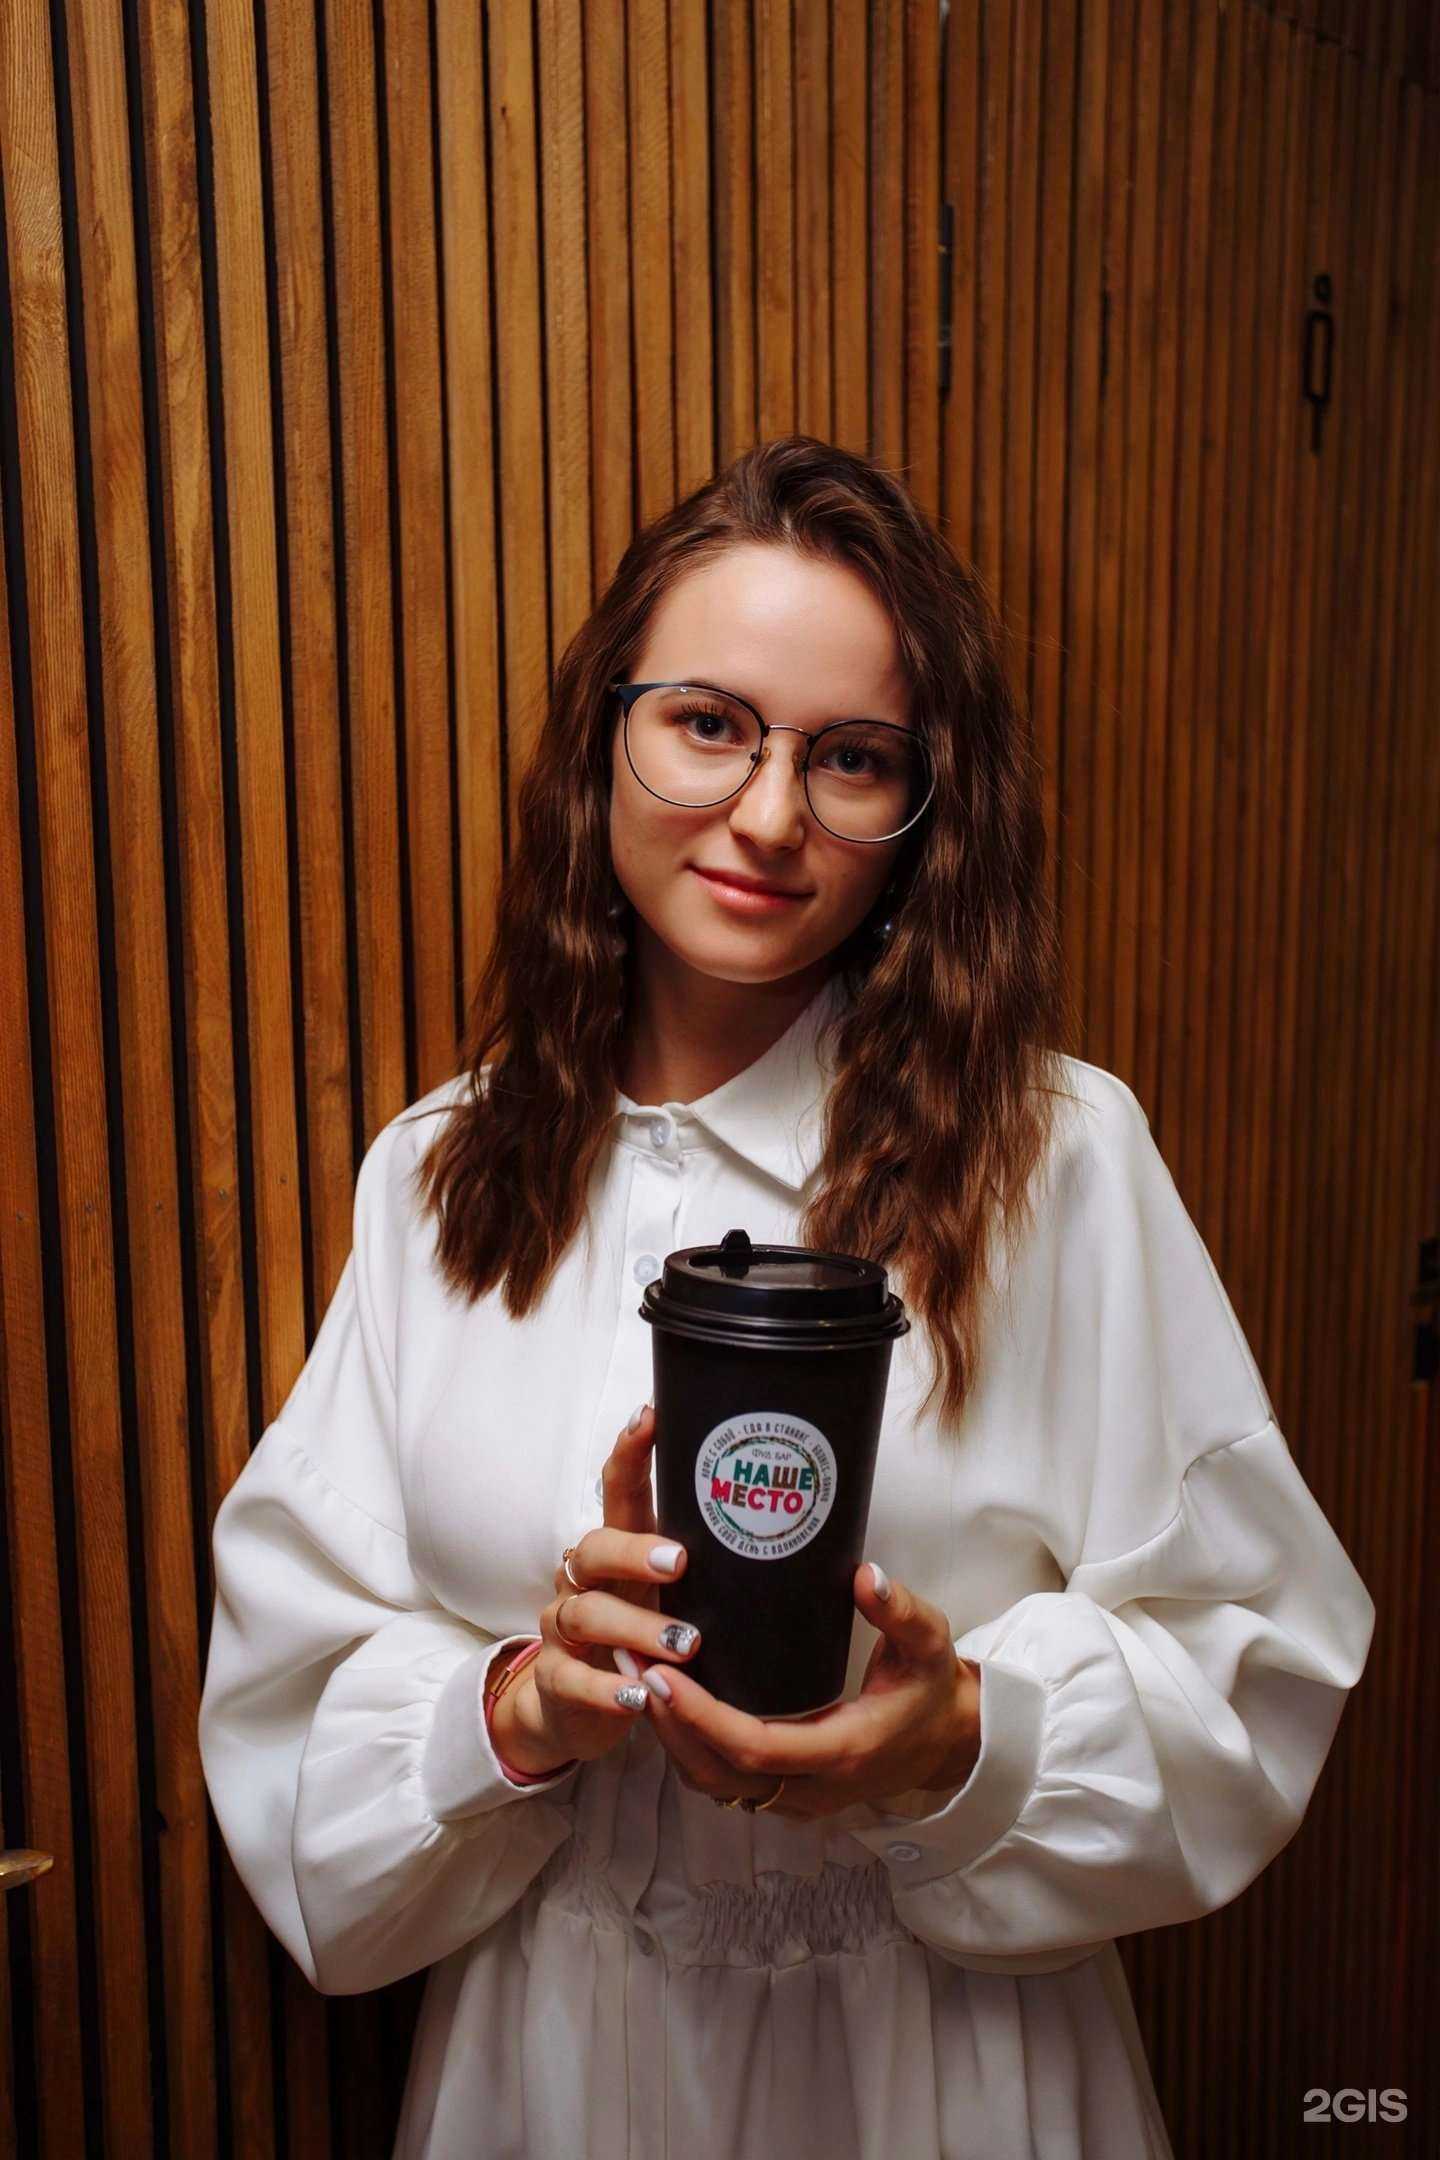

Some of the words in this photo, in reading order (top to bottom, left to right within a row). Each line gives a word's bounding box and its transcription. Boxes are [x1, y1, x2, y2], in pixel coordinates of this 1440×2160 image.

[743, 1422, 762, 1435] ЕДА
[733, 1459, 814, 1490] НАШЕ
[711, 1477, 804, 1514] МЕСТО
